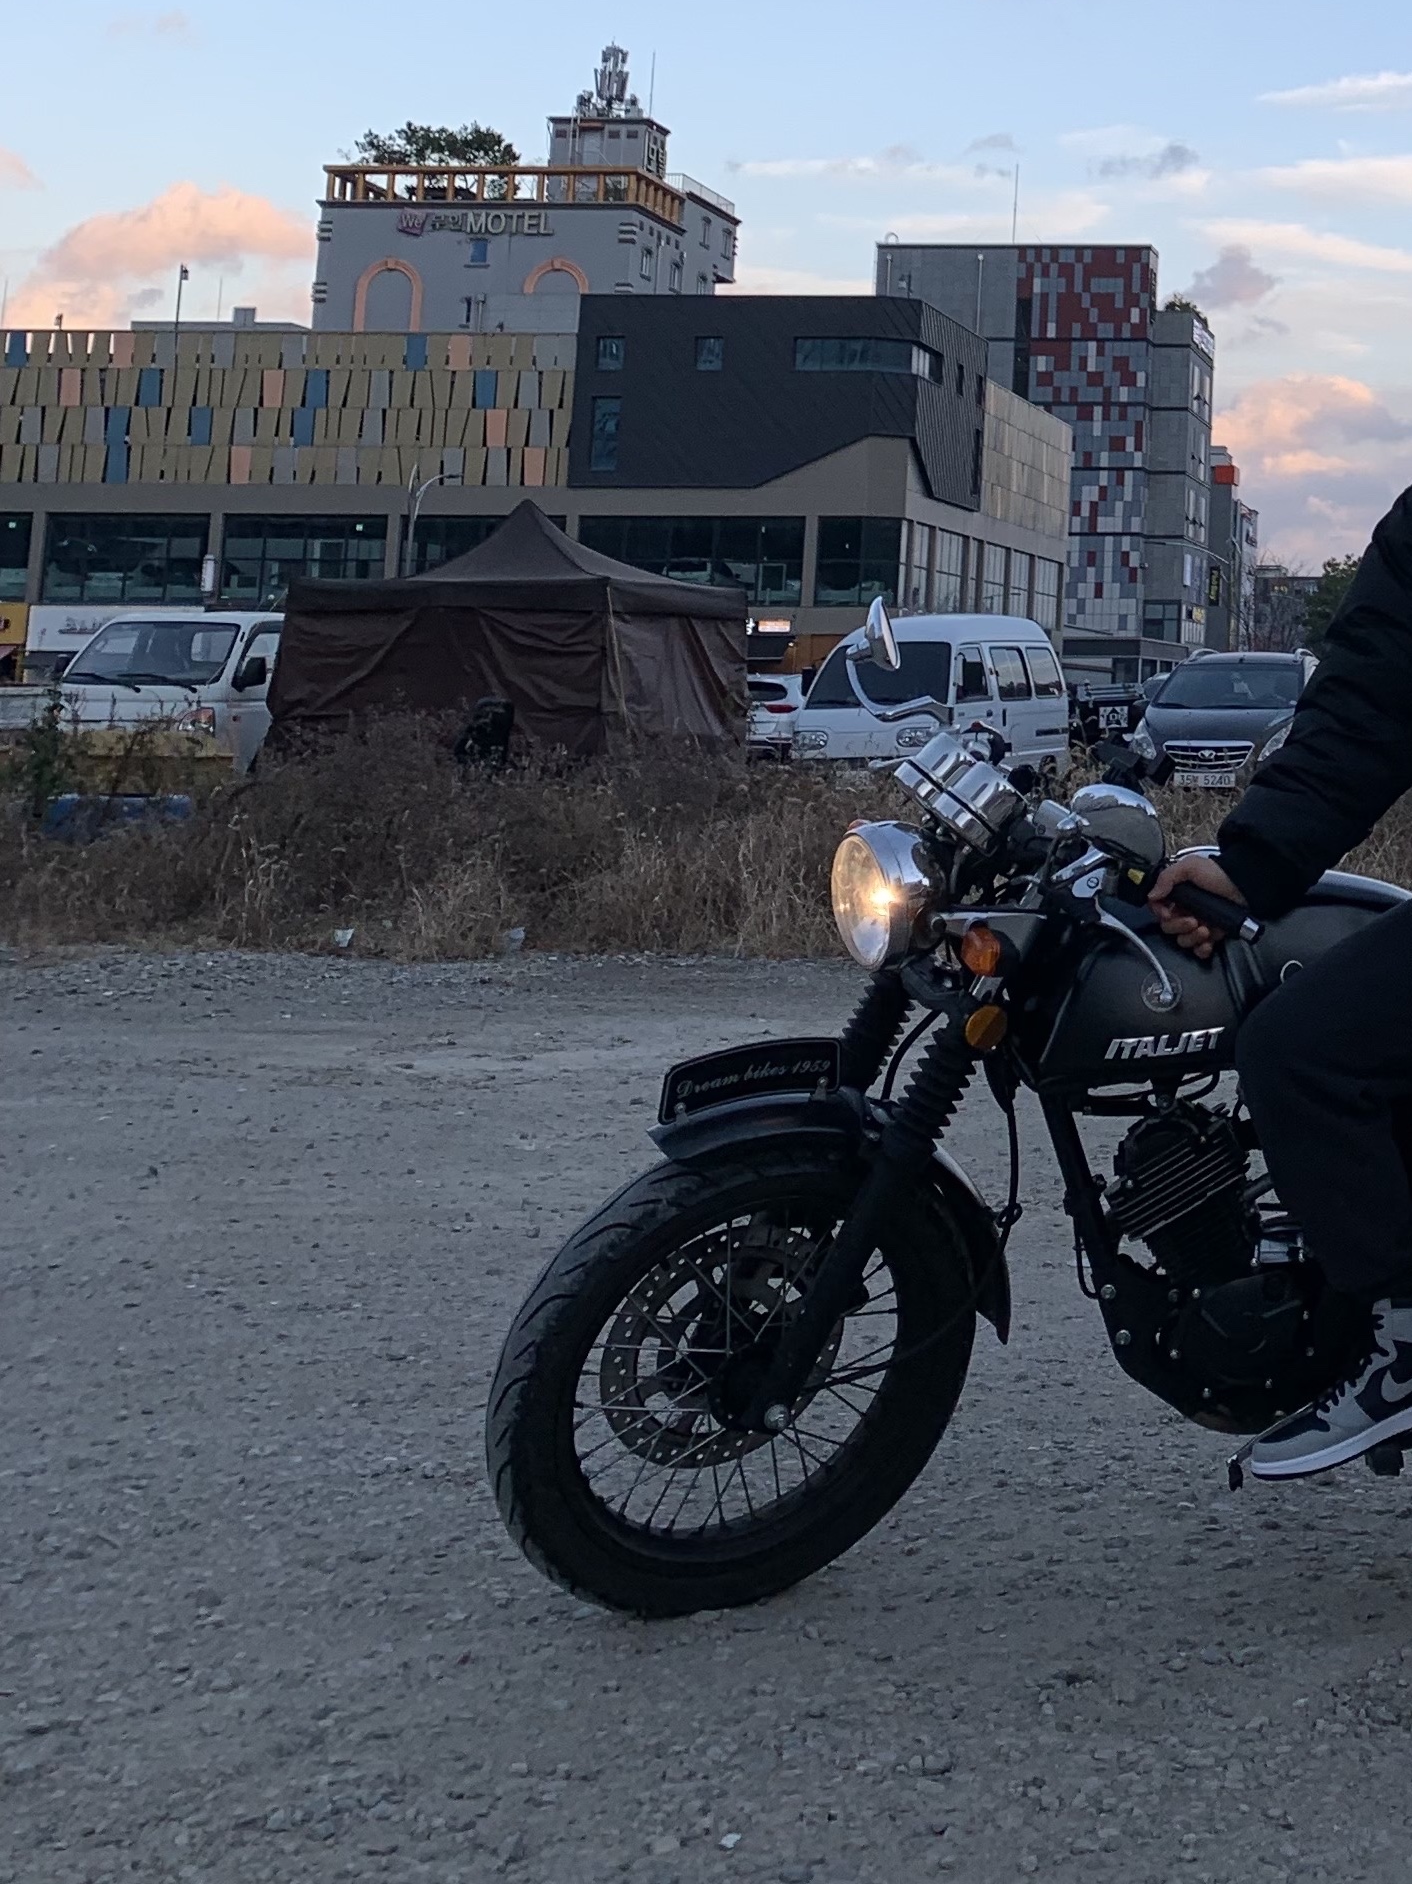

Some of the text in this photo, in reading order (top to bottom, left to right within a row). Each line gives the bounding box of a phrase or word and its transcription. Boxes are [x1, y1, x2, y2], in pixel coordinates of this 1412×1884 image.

[400, 212, 422, 228] We
[466, 211, 554, 235] MOTEL
[1203, 774, 1231, 786] 5240
[1104, 1026, 1225, 1059] ITALJET
[675, 1059, 832, 1100] Dream bikes 1959
